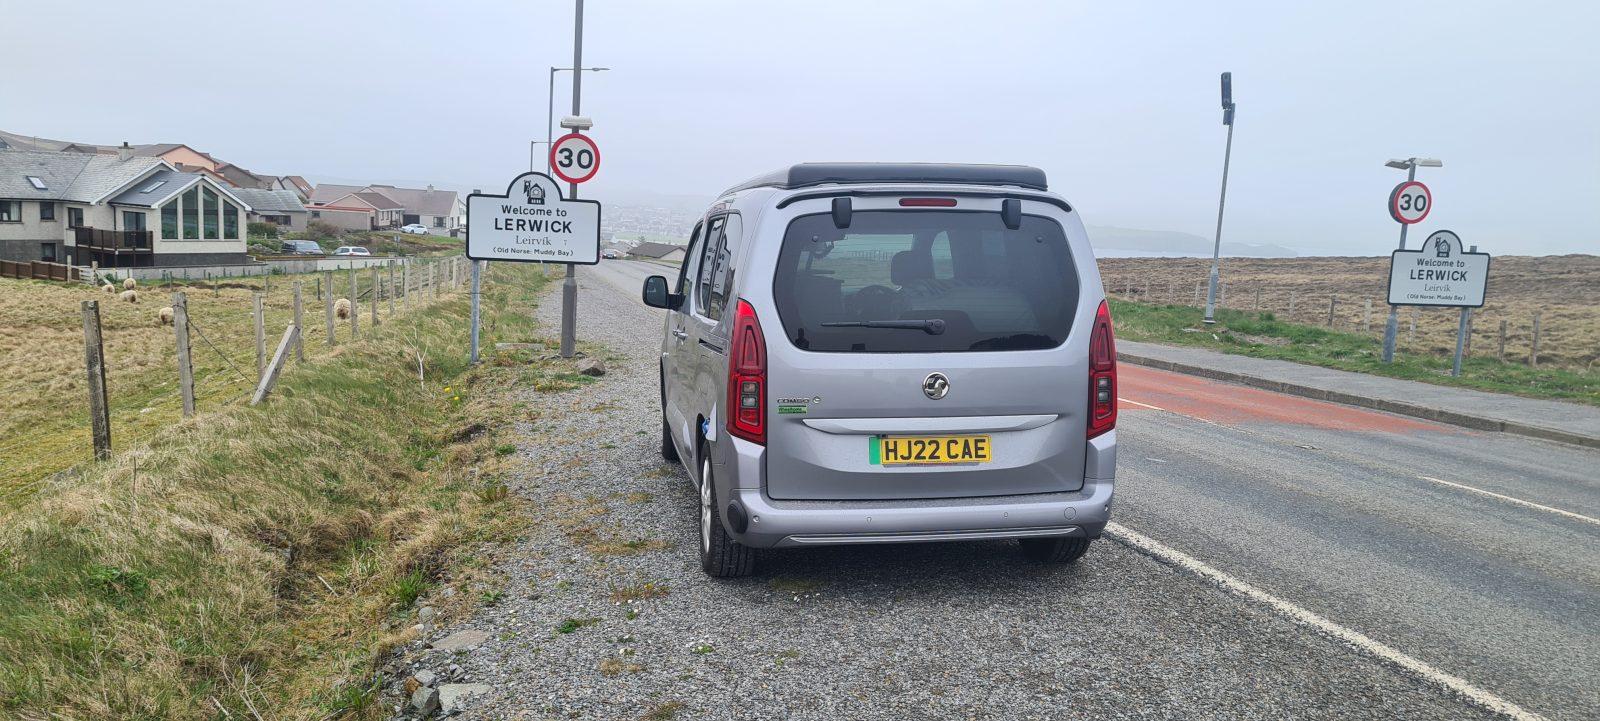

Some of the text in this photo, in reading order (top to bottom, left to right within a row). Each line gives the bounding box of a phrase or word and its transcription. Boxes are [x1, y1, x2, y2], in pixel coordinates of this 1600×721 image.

[558, 148, 593, 169] 30
[1400, 194, 1427, 212] 30
[502, 205, 567, 217] Welcome to
[495, 218, 572, 233] LERWICK
[1417, 259, 1465, 268] Welcome to
[1410, 269, 1468, 281] LERWICK
[885, 439, 987, 460] HJ22 CAE
